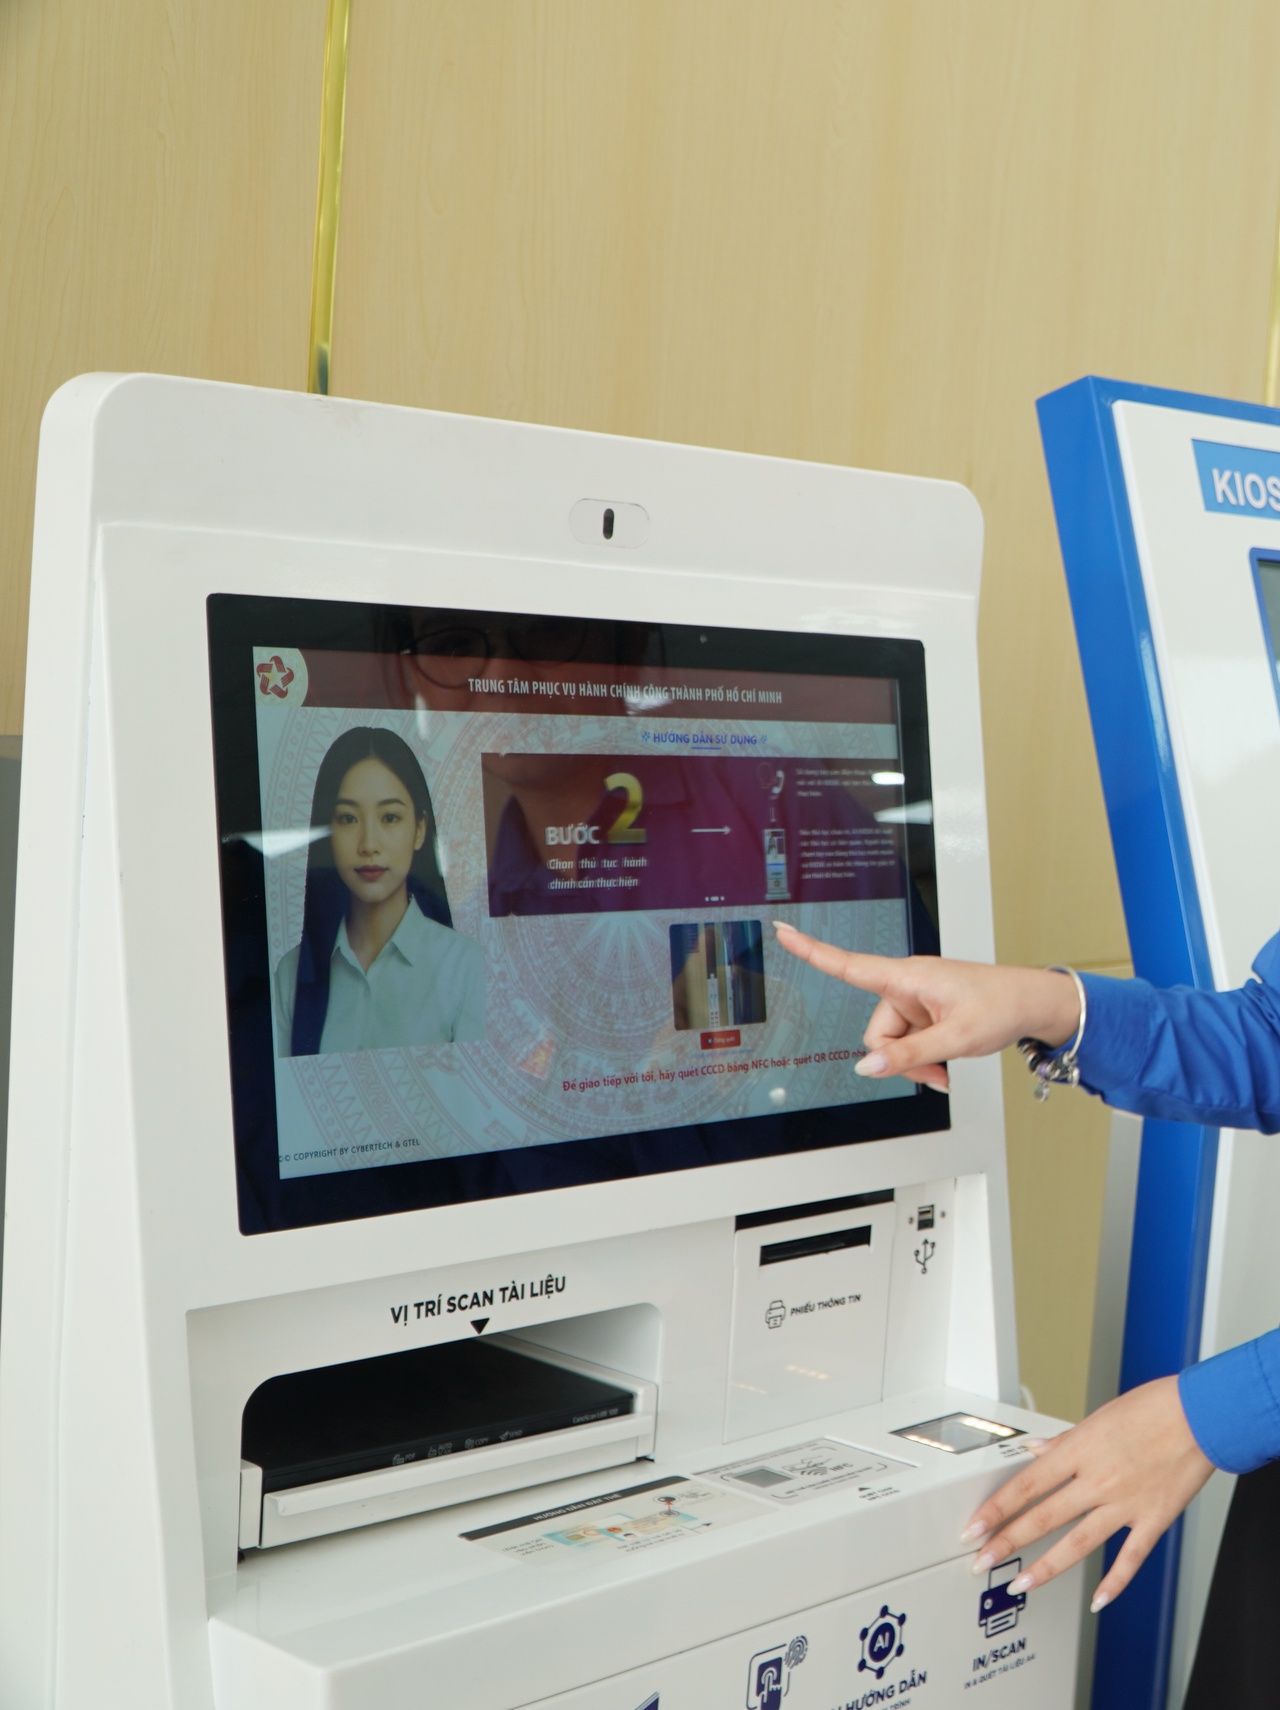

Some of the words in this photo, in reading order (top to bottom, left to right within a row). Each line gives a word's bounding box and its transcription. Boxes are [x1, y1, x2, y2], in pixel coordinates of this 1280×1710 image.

[468, 678, 505, 693] TRUNG
[507, 678, 529, 694] TÂM
[532, 681, 560, 698] PHỤC
[562, 683, 576, 699] VỤ
[579, 681, 607, 697] HÀNH
[670, 685, 703, 701] THÀNH
[758, 690, 782, 704] MINH
[545, 823, 600, 845] BƯỚC
[604, 772, 648, 845] 2
[547, 858, 574, 872] Chọn
[623, 856, 647, 868] hành
[579, 1080, 600, 1092] giao
[603, 1073, 622, 1088] tiếp
[624, 1072, 639, 1085] với
[659, 1069, 676, 1082] hãy
[678, 1066, 699, 1080] quét
[701, 1064, 725, 1076] CCCD
[751, 1058, 769, 1070] NFC
[770, 1057, 790, 1069] hoặc
[793, 1054, 812, 1066] quét
[814, 1052, 826, 1063] QR
[828, 1050, 849, 1061] CCCD
[293, 1149, 337, 1161] COPYRIGHT
[339, 1147, 349, 1155] BY
[351, 1142, 393, 1154] CYBERTECH
[402, 1138, 420, 1147] GTEL
[390, 1305, 408, 1326] VỊ
[413, 1293, 443, 1319] TRÍ
[446, 1289, 494, 1313] SCAN
[499, 1280, 525, 1303] TÀI
[530, 1274, 566, 1299] LIỆU
[873, 1631, 889, 1652] AI
[972, 1637, 1027, 1671] IN/SCAN
[899, 1669, 927, 1694] DẪN
